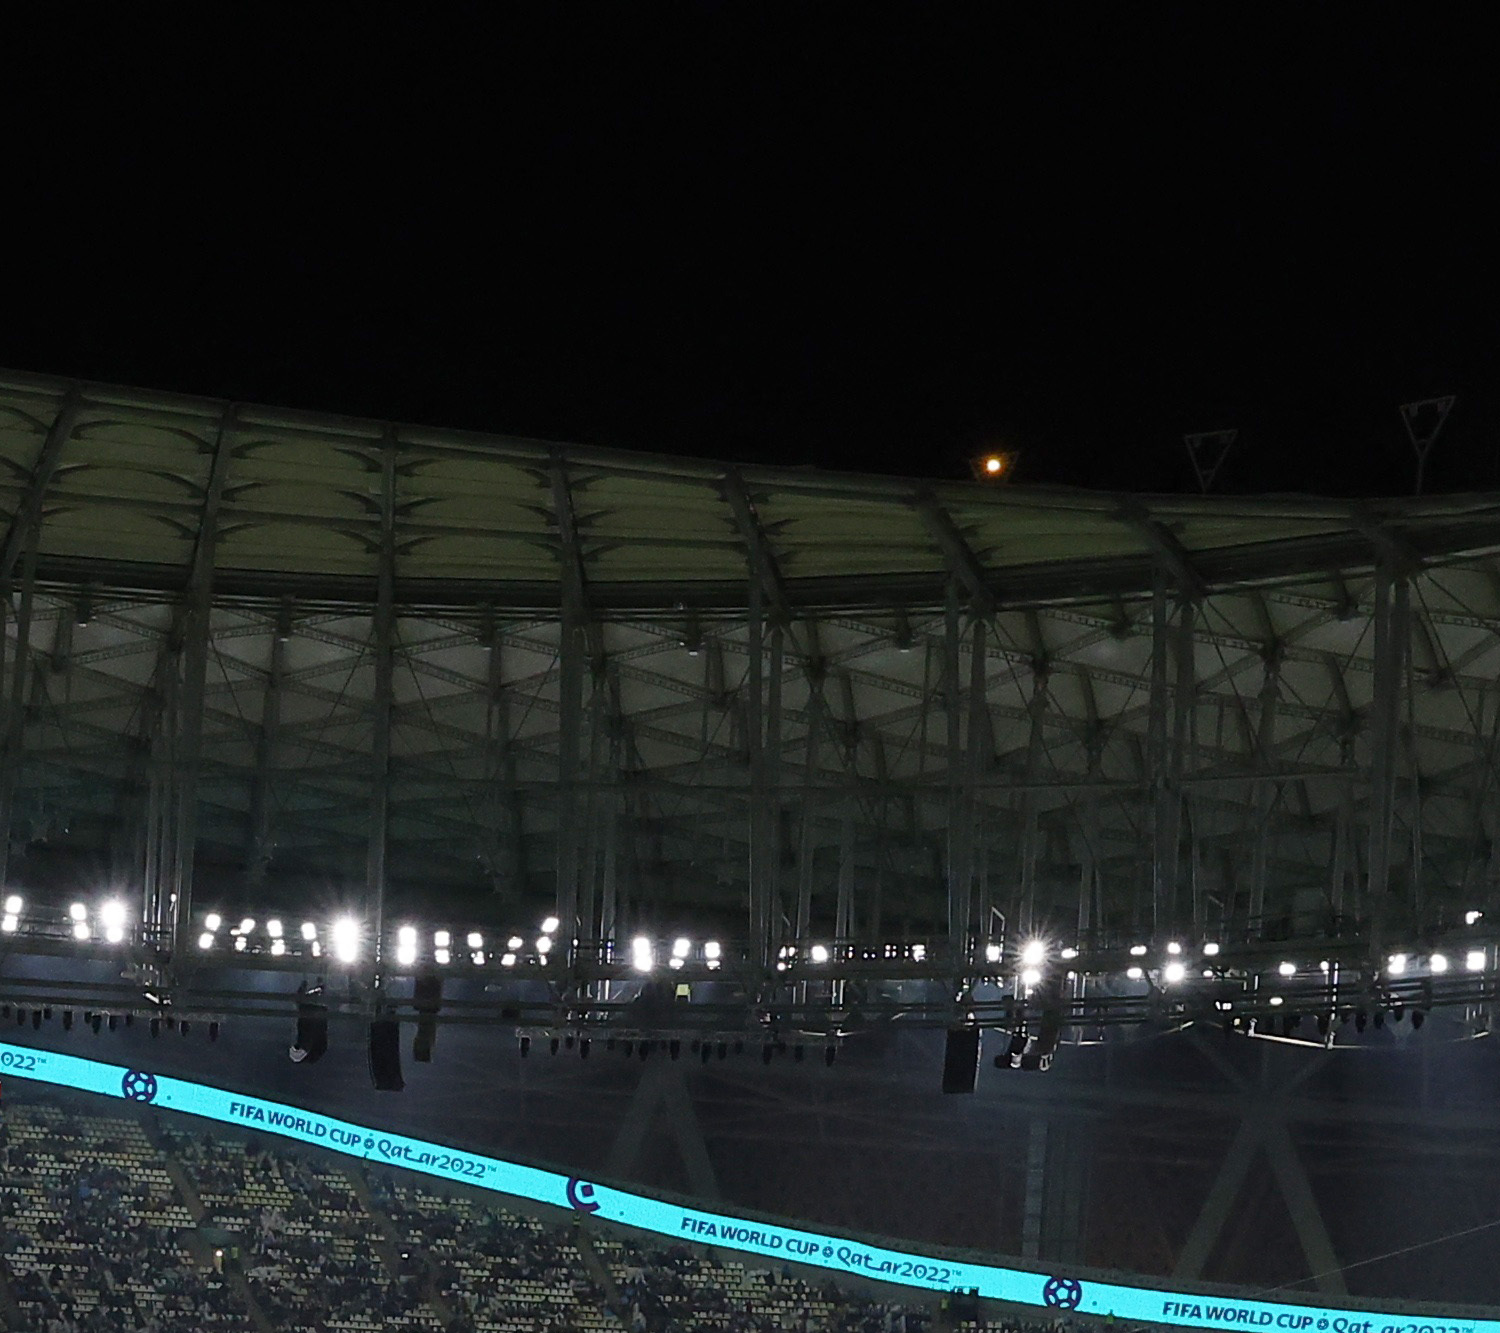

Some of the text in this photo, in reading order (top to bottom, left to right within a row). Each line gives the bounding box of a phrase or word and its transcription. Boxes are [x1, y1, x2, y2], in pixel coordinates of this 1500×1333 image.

[230, 1102, 264, 1123] FIFA
[267, 1110, 327, 1138] WORLD
[330, 1127, 361, 1148] CUP
[681, 1217, 717, 1238] FIFA
[720, 1223, 782, 1250] WORLD
[786, 1238, 820, 1257] CUP
[1163, 1300, 1201, 1318] FIFA
[1205, 1306, 1273, 1326] WORLD
[1278, 1313, 1313, 1331] CUP
